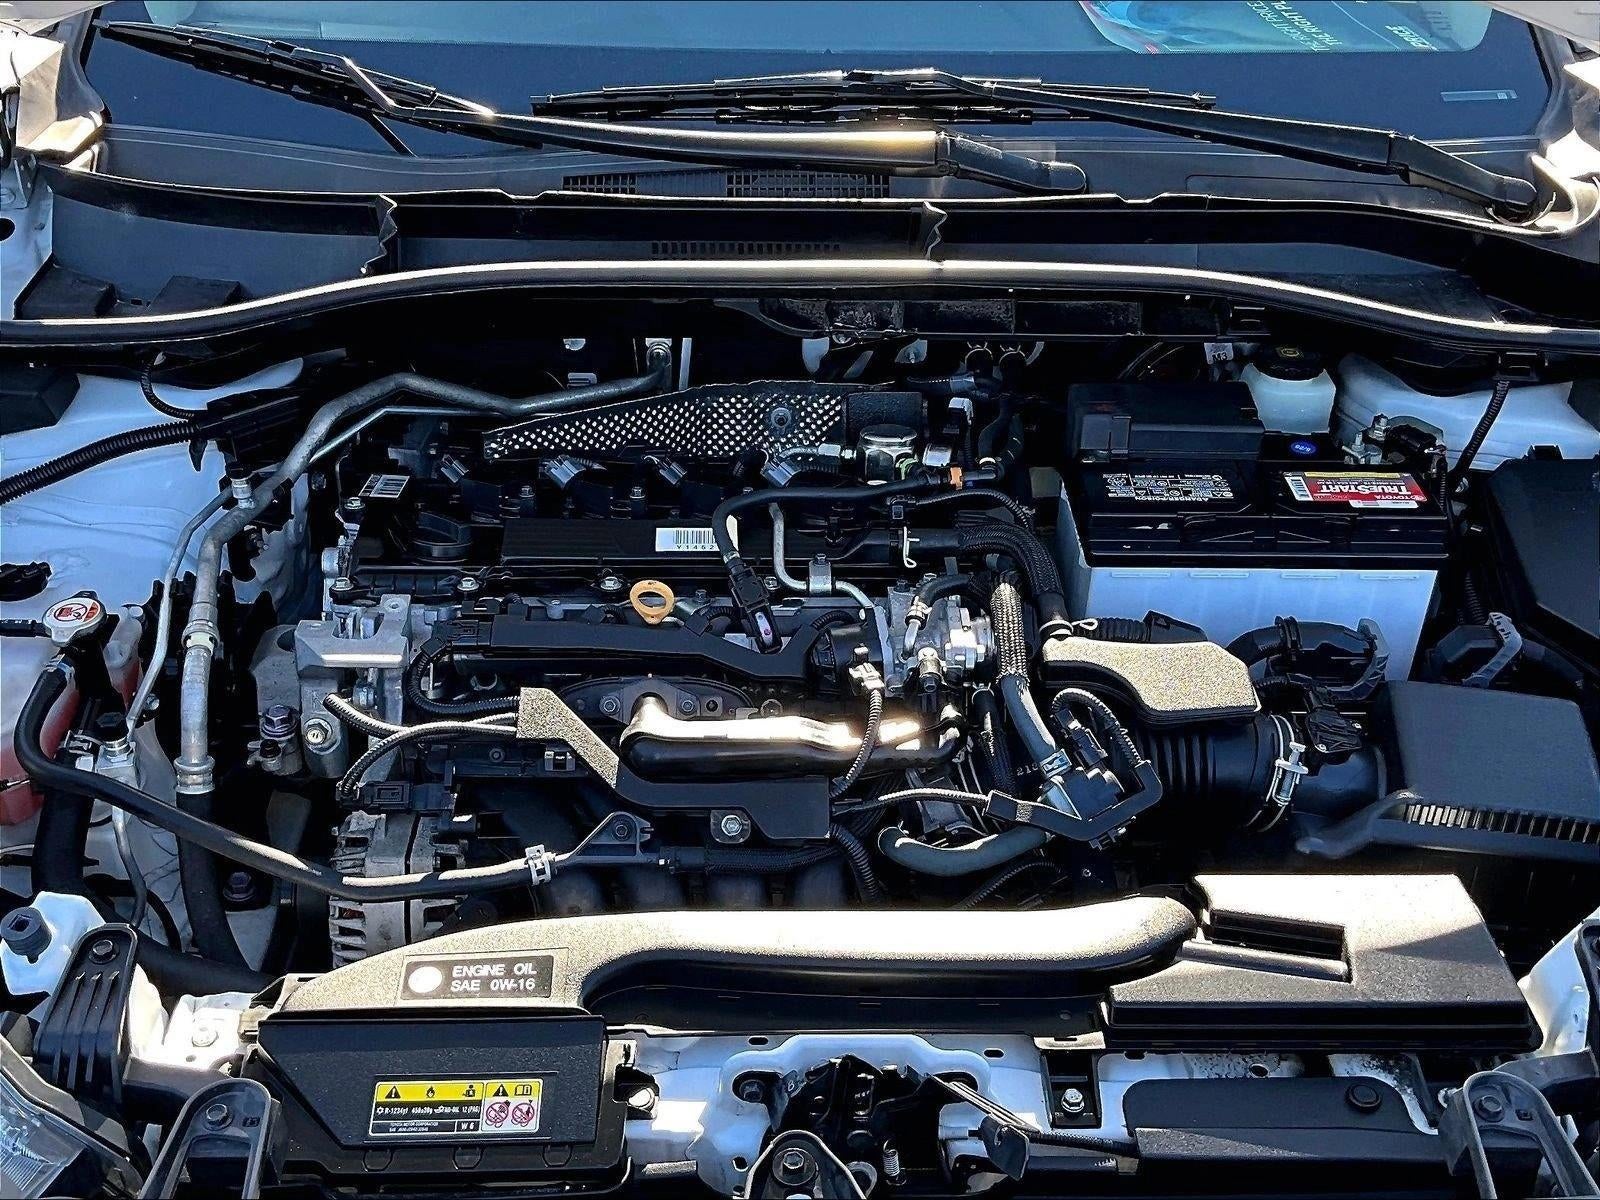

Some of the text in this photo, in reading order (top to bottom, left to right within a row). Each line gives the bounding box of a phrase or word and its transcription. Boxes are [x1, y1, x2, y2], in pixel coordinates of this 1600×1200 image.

[1246, 1, 1284, 23] PRICE
[1281, 11, 1322, 36] RIGHT
[1319, 32, 1346, 46] THE
[452, 963, 538, 977] ENGINE OIL
[450, 978, 536, 992] SAE 0W-16
